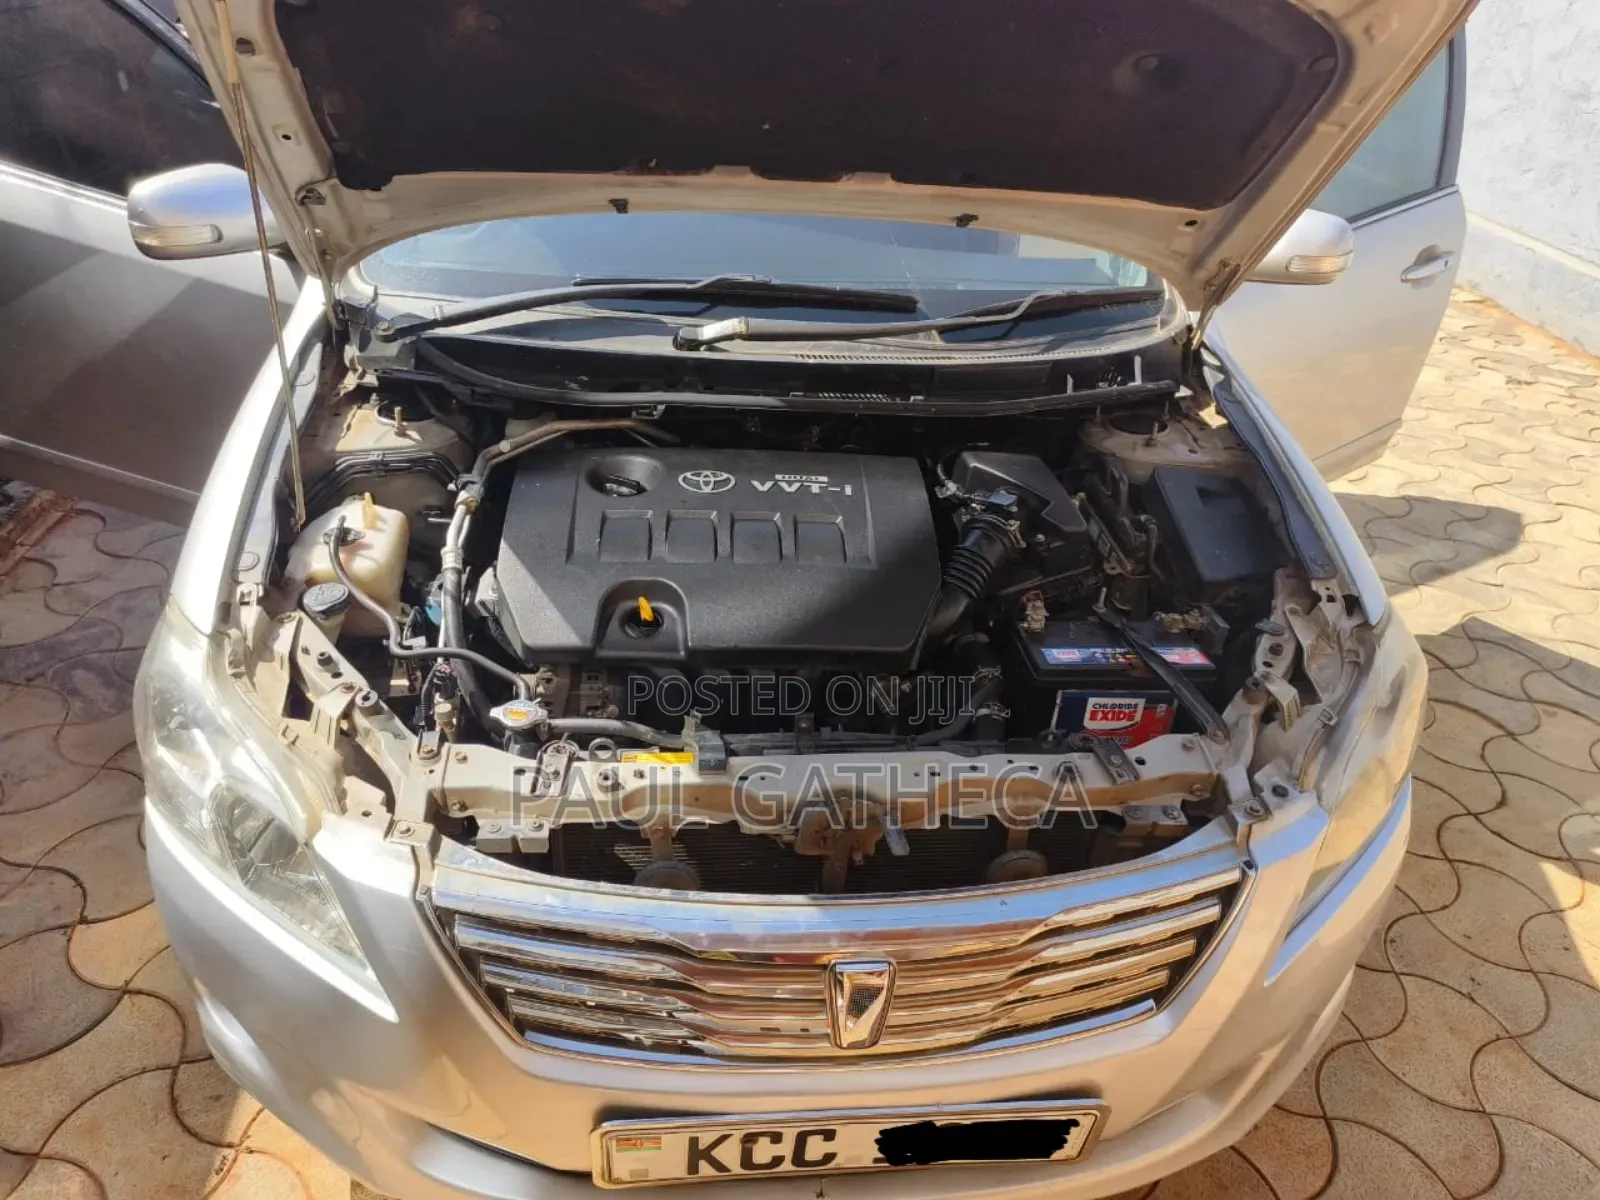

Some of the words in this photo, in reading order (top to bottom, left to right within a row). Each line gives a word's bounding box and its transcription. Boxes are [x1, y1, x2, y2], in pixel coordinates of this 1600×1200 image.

[1092, 702, 1139, 710] CHLORIDE
[1089, 709, 1137, 722] EXIDE
[686, 1128, 838, 1176] KCC
